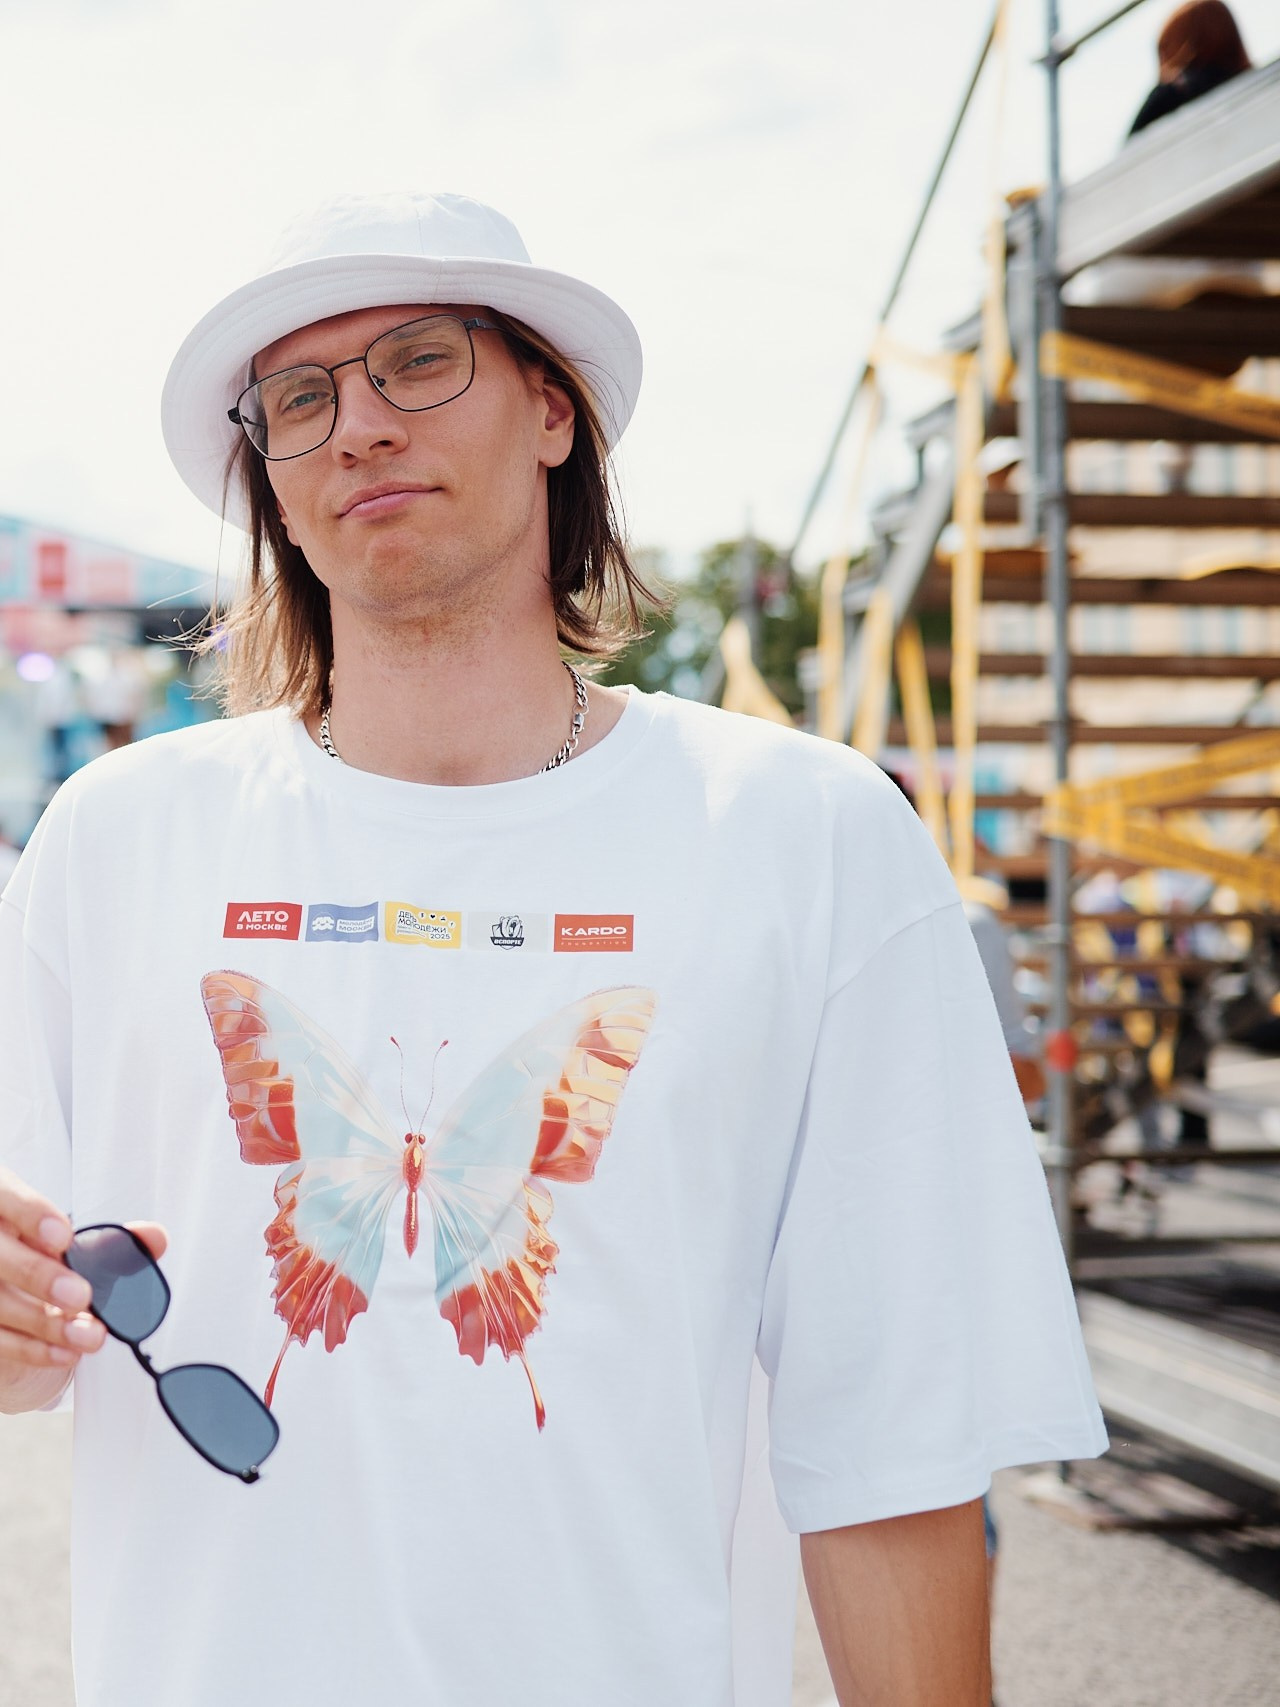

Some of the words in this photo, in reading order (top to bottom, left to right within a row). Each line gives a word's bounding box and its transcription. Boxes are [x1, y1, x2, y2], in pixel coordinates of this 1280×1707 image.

[238, 910, 289, 923] ЛЕТО
[398, 911, 417, 922] ДЕНЬ
[245, 923, 288, 931] МОСКВЕ
[561, 926, 627, 936] KARDO
